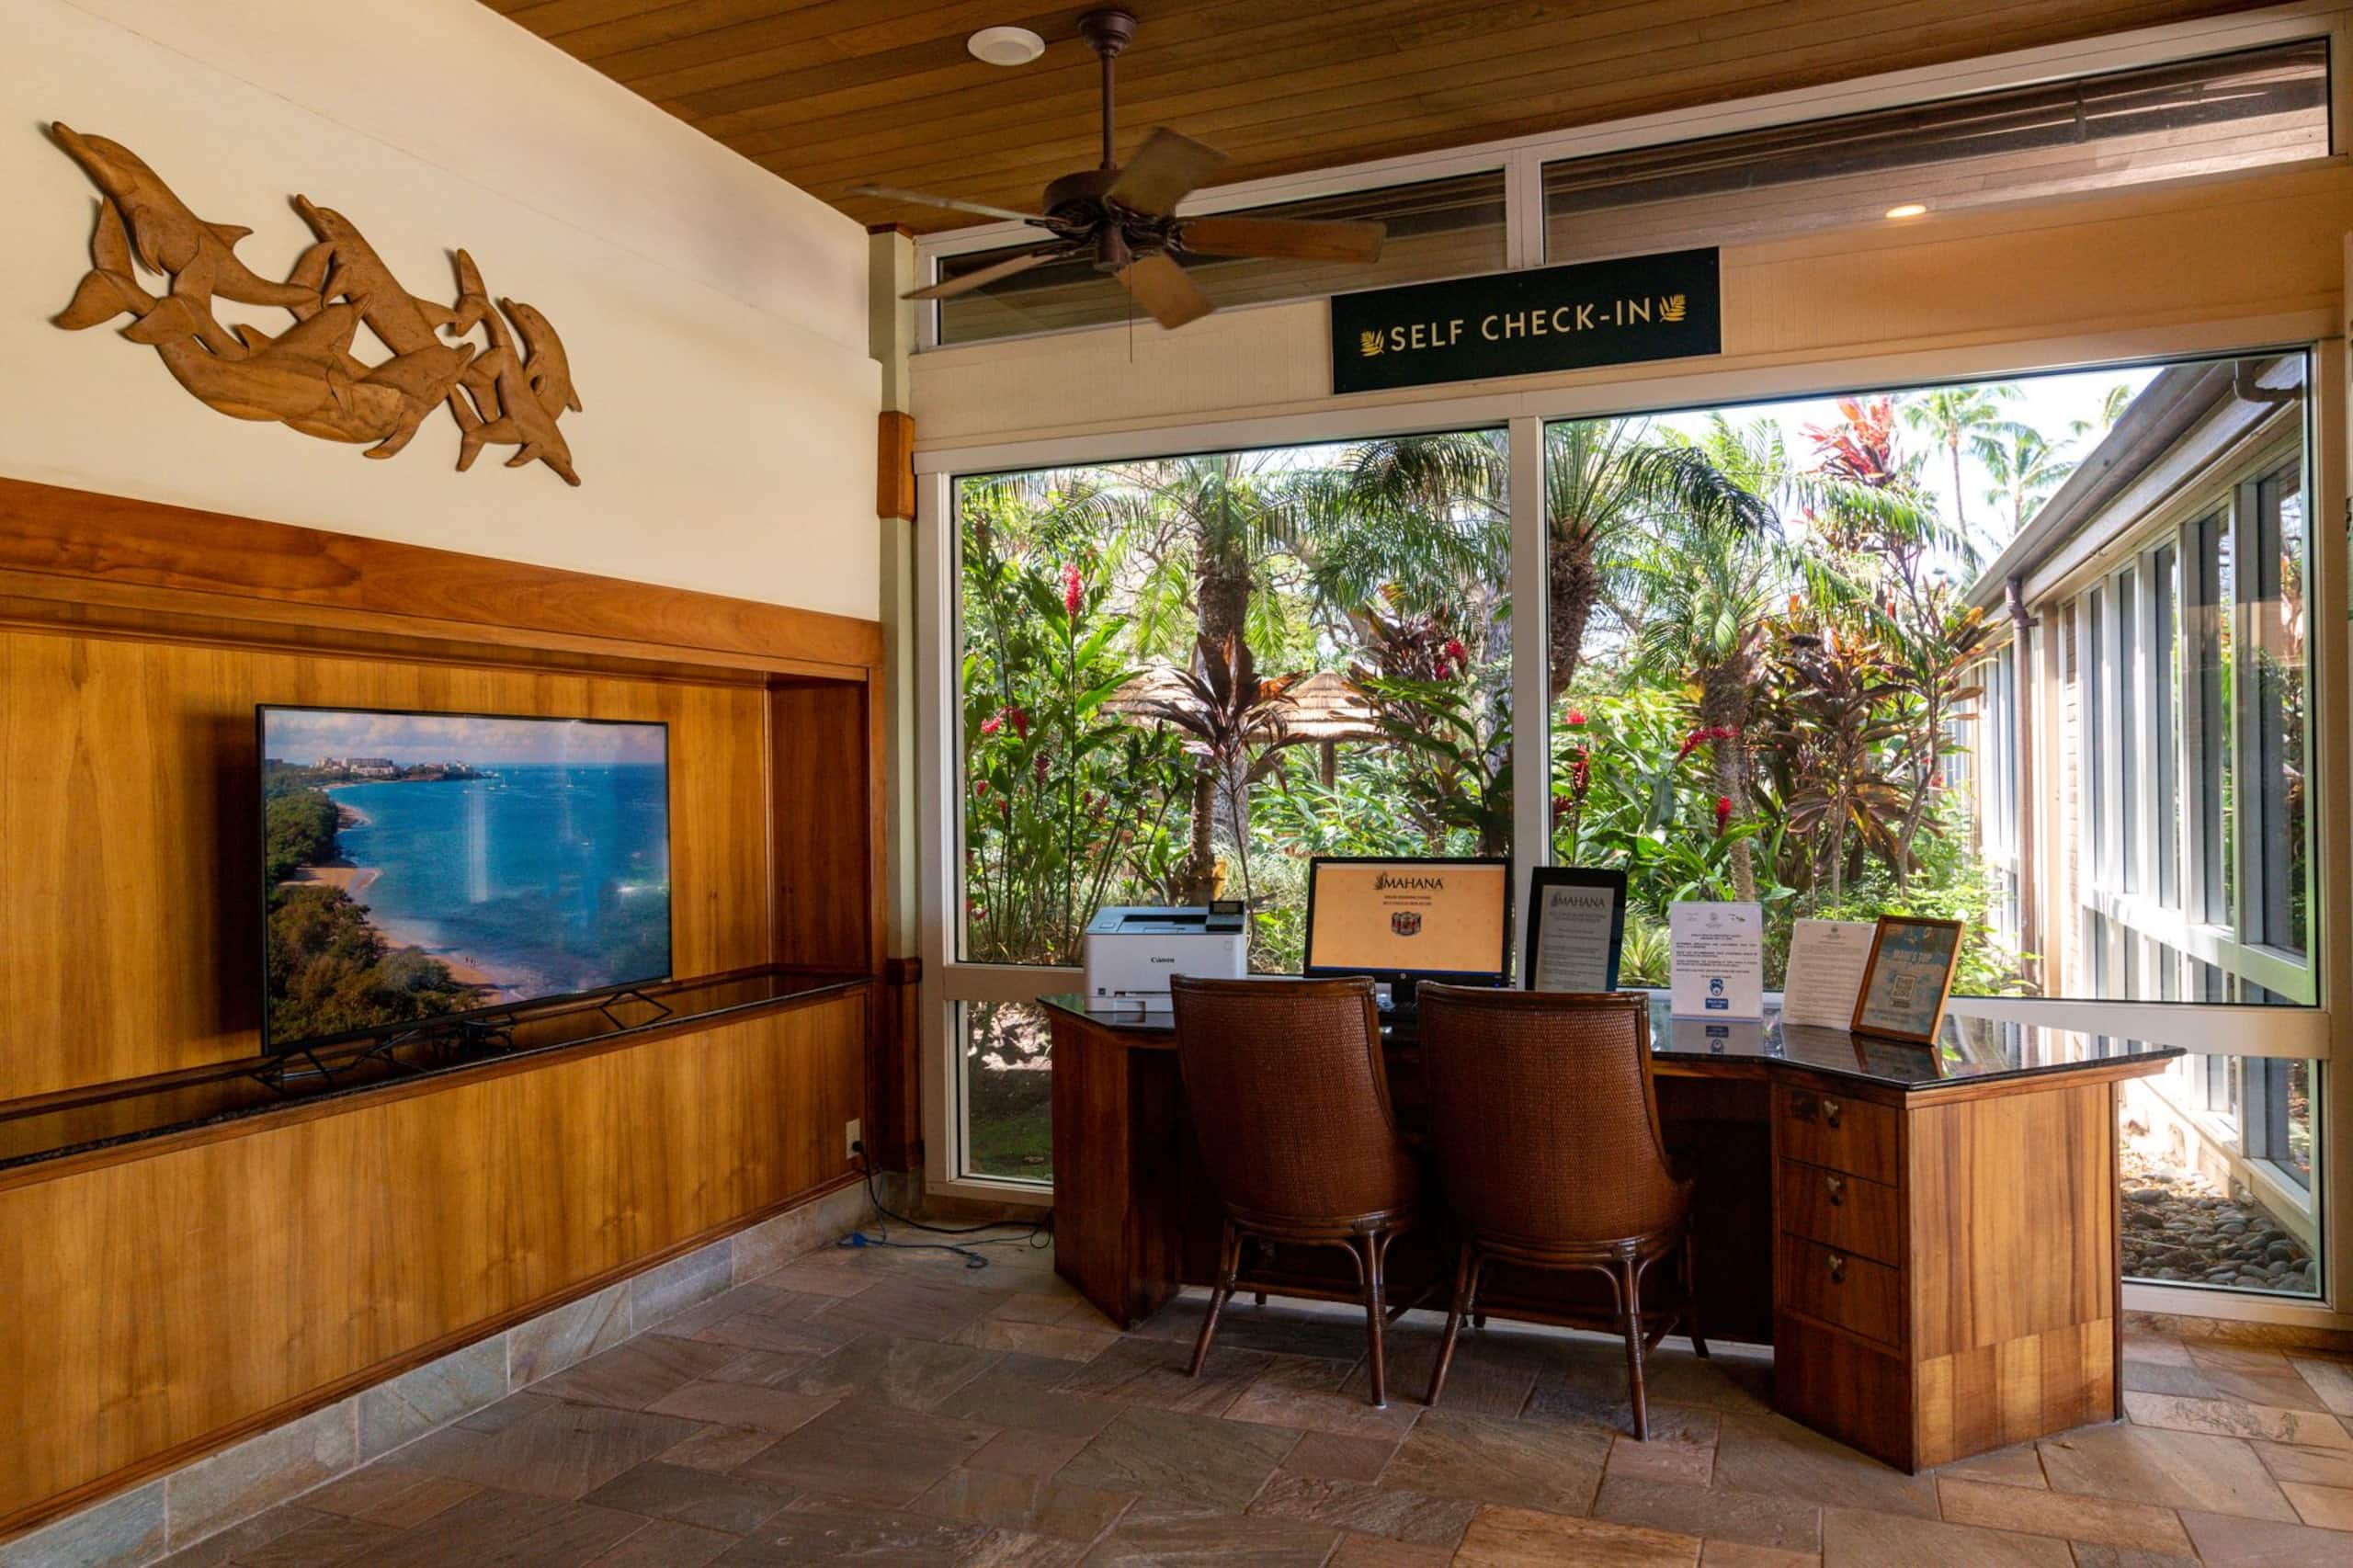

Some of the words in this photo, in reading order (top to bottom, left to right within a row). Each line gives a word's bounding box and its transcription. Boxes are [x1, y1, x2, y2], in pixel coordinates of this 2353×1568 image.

[1390, 319, 1464, 352] SELF
[1481, 297, 1652, 342] CHECK-IN
[1383, 877, 1443, 890] MAHANA
[1558, 896, 1605, 909] MAHANA
